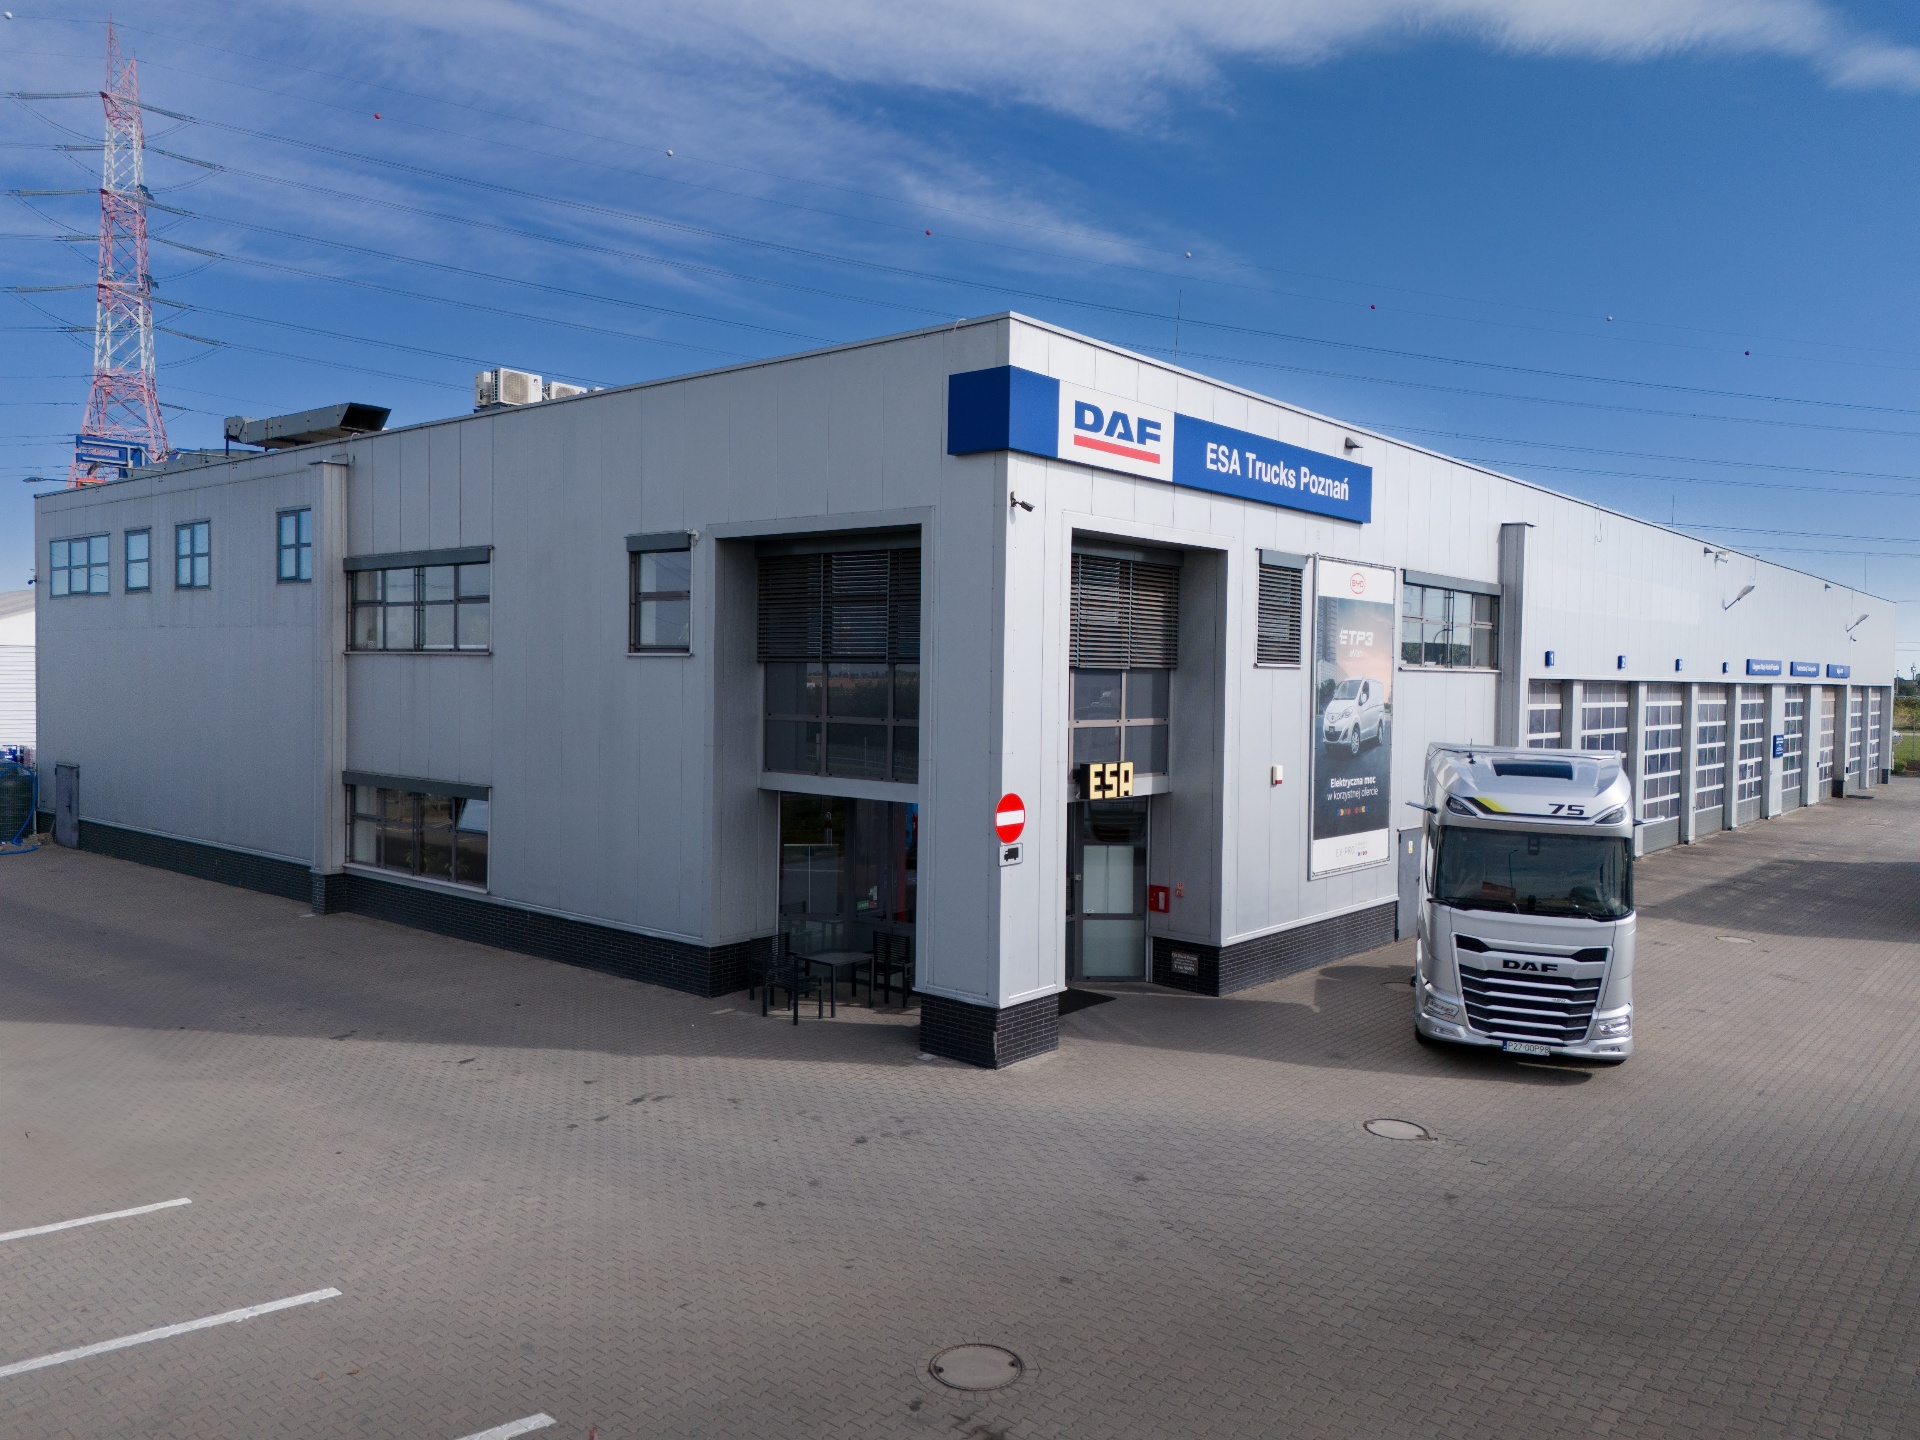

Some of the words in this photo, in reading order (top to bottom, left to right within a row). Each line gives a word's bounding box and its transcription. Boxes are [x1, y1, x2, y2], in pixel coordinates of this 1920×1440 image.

[1074, 399, 1162, 446] DAF
[1206, 442, 1241, 476] ESA
[1245, 451, 1296, 489] Trucks
[1300, 466, 1349, 501] Poznań
[1351, 579, 1364, 588] BYD
[1339, 628, 1373, 646] ETP3
[1089, 761, 1134, 800] ESA
[1330, 777, 1363, 788] Elektryczna
[1364, 776, 1376, 785] moc
[1333, 788, 1361, 801] korzystnej
[1361, 786, 1379, 797] ofercie
[1548, 803, 1585, 816] 75
[1502, 960, 1558, 972] DAF
